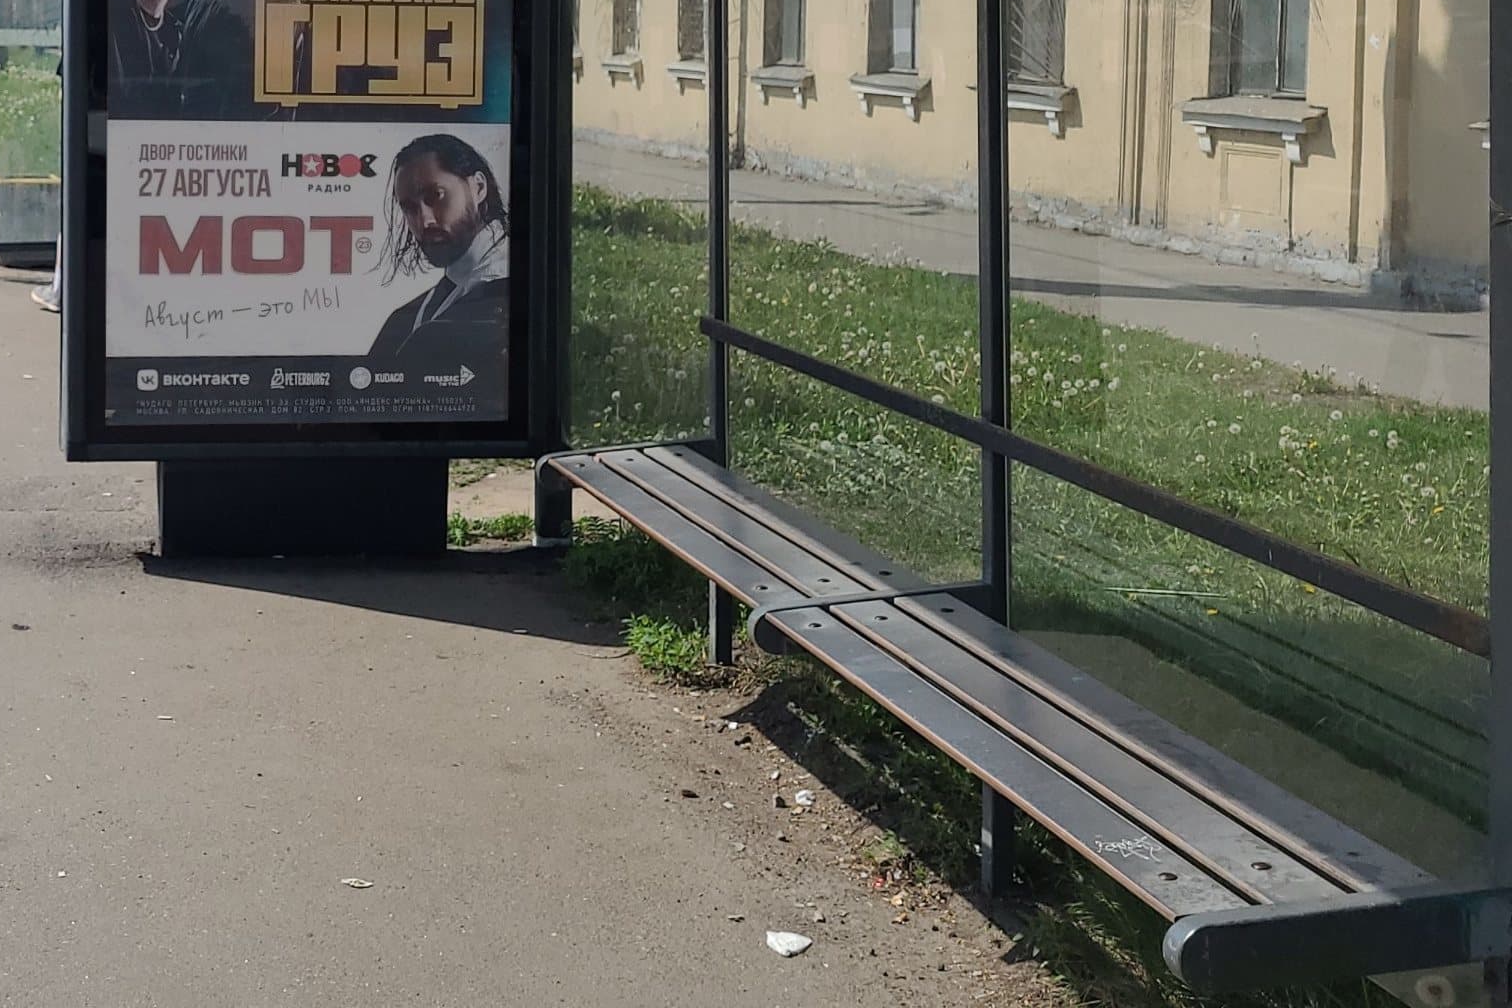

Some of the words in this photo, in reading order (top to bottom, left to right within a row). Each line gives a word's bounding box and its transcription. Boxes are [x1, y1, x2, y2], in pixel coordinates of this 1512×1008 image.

[265, 1, 474, 96] ГРУЗ
[139, 143, 176, 162] ДВОР
[178, 144, 248, 161] ГОСТИНКИ
[138, 168, 167, 197] 27
[172, 168, 272, 198] АВГУСТА
[307, 184, 352, 194] РАДИО
[139, 215, 374, 275] МОТ
[144, 300, 224, 339] Август
[257, 300, 293, 318] это
[302, 285, 341, 311] МЫ
